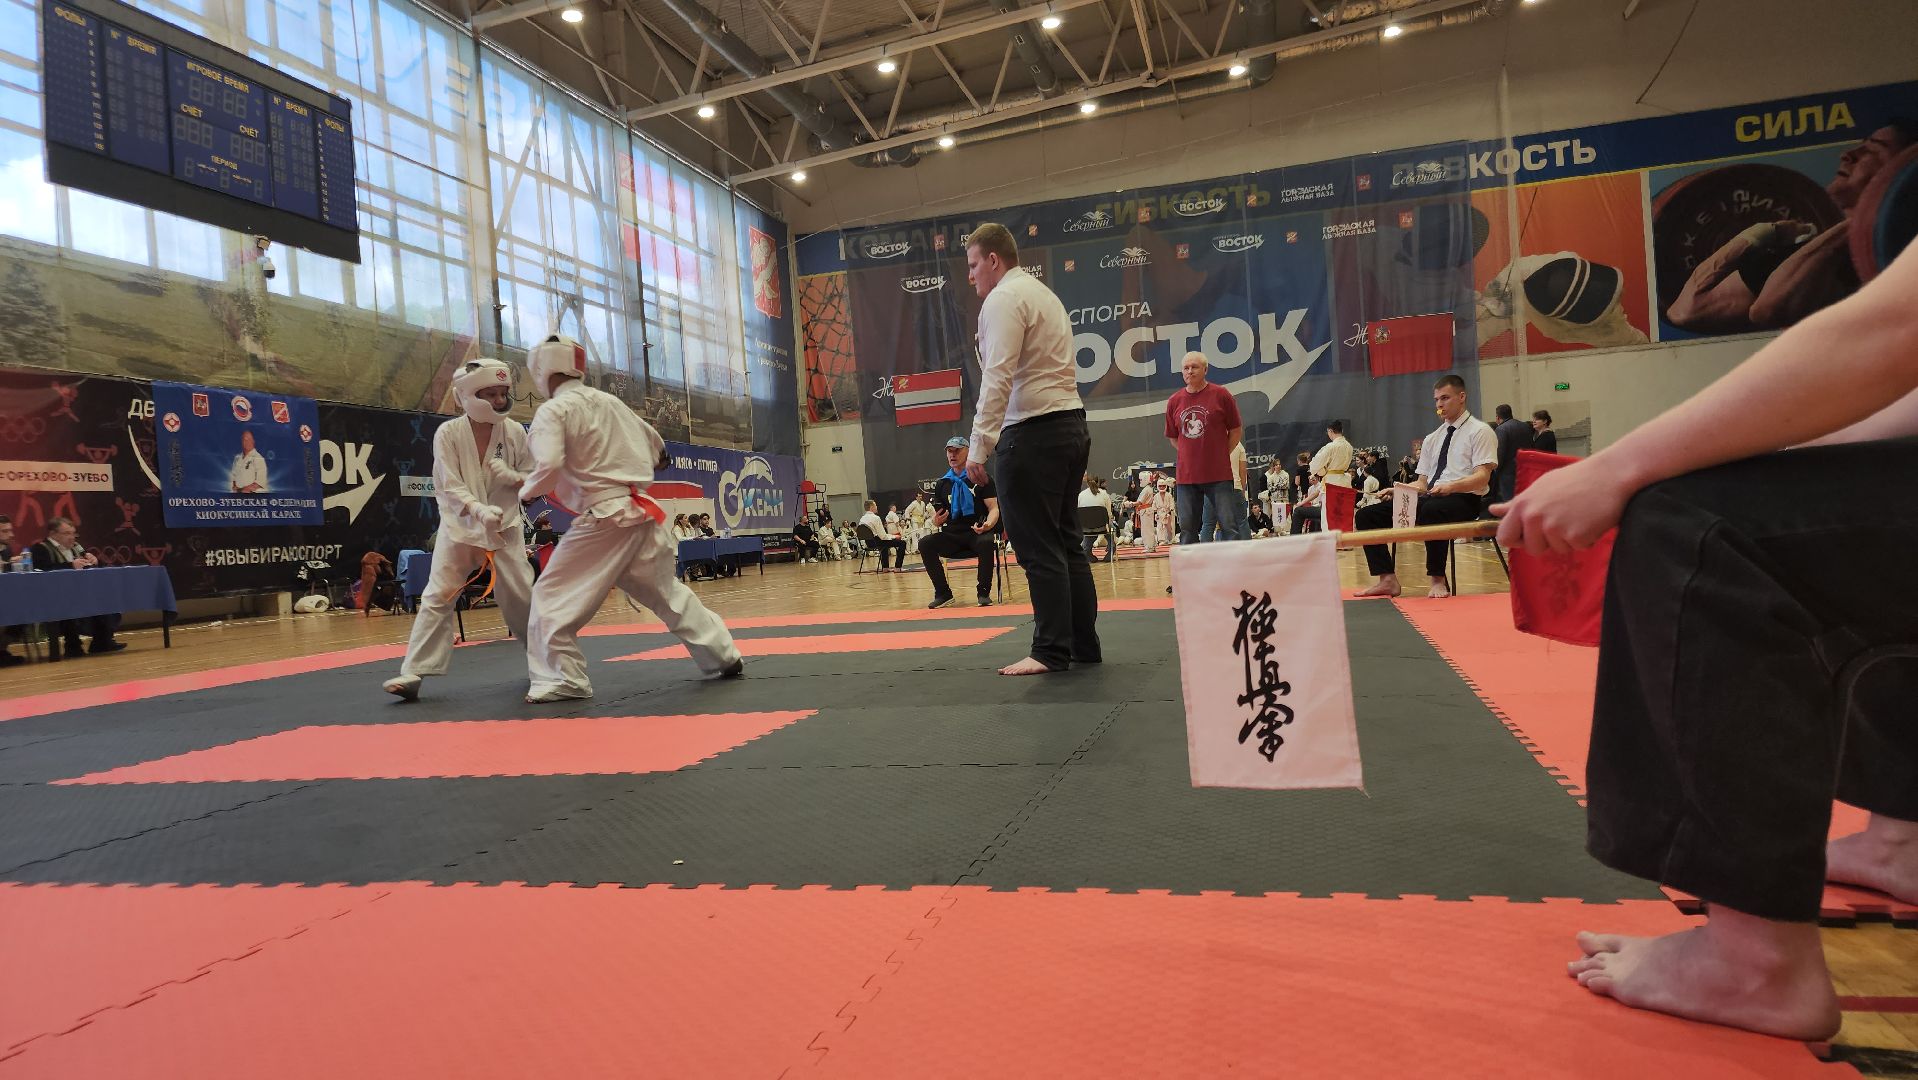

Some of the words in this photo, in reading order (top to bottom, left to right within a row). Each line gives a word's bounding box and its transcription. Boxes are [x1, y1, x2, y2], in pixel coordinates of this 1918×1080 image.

[224, 76, 250, 93] ВРЕМЯ
[1735, 102, 1856, 143] СИЛА
[1179, 198, 1223, 213] ВОСТОК
[1063, 218, 1111, 233] Северный
[870, 241, 910, 256] ВОСТОК
[1218, 234, 1263, 249] ВОСТОК
[1099, 253, 1148, 269] Северный
[905, 275, 945, 289] ВОСТОК
[1069, 301, 1153, 326] СПОРТА
[1074, 308, 1309, 384] ОСТОК
[127, 398, 155, 420] ДВ
[168, 497, 267, 508] ОРЕХОВО-ЗУЕВСКАЯ
[719, 470, 784, 528] ОКЕАН
[204, 544, 343, 568] #ЯВЫБИРАЮСПОРТ
